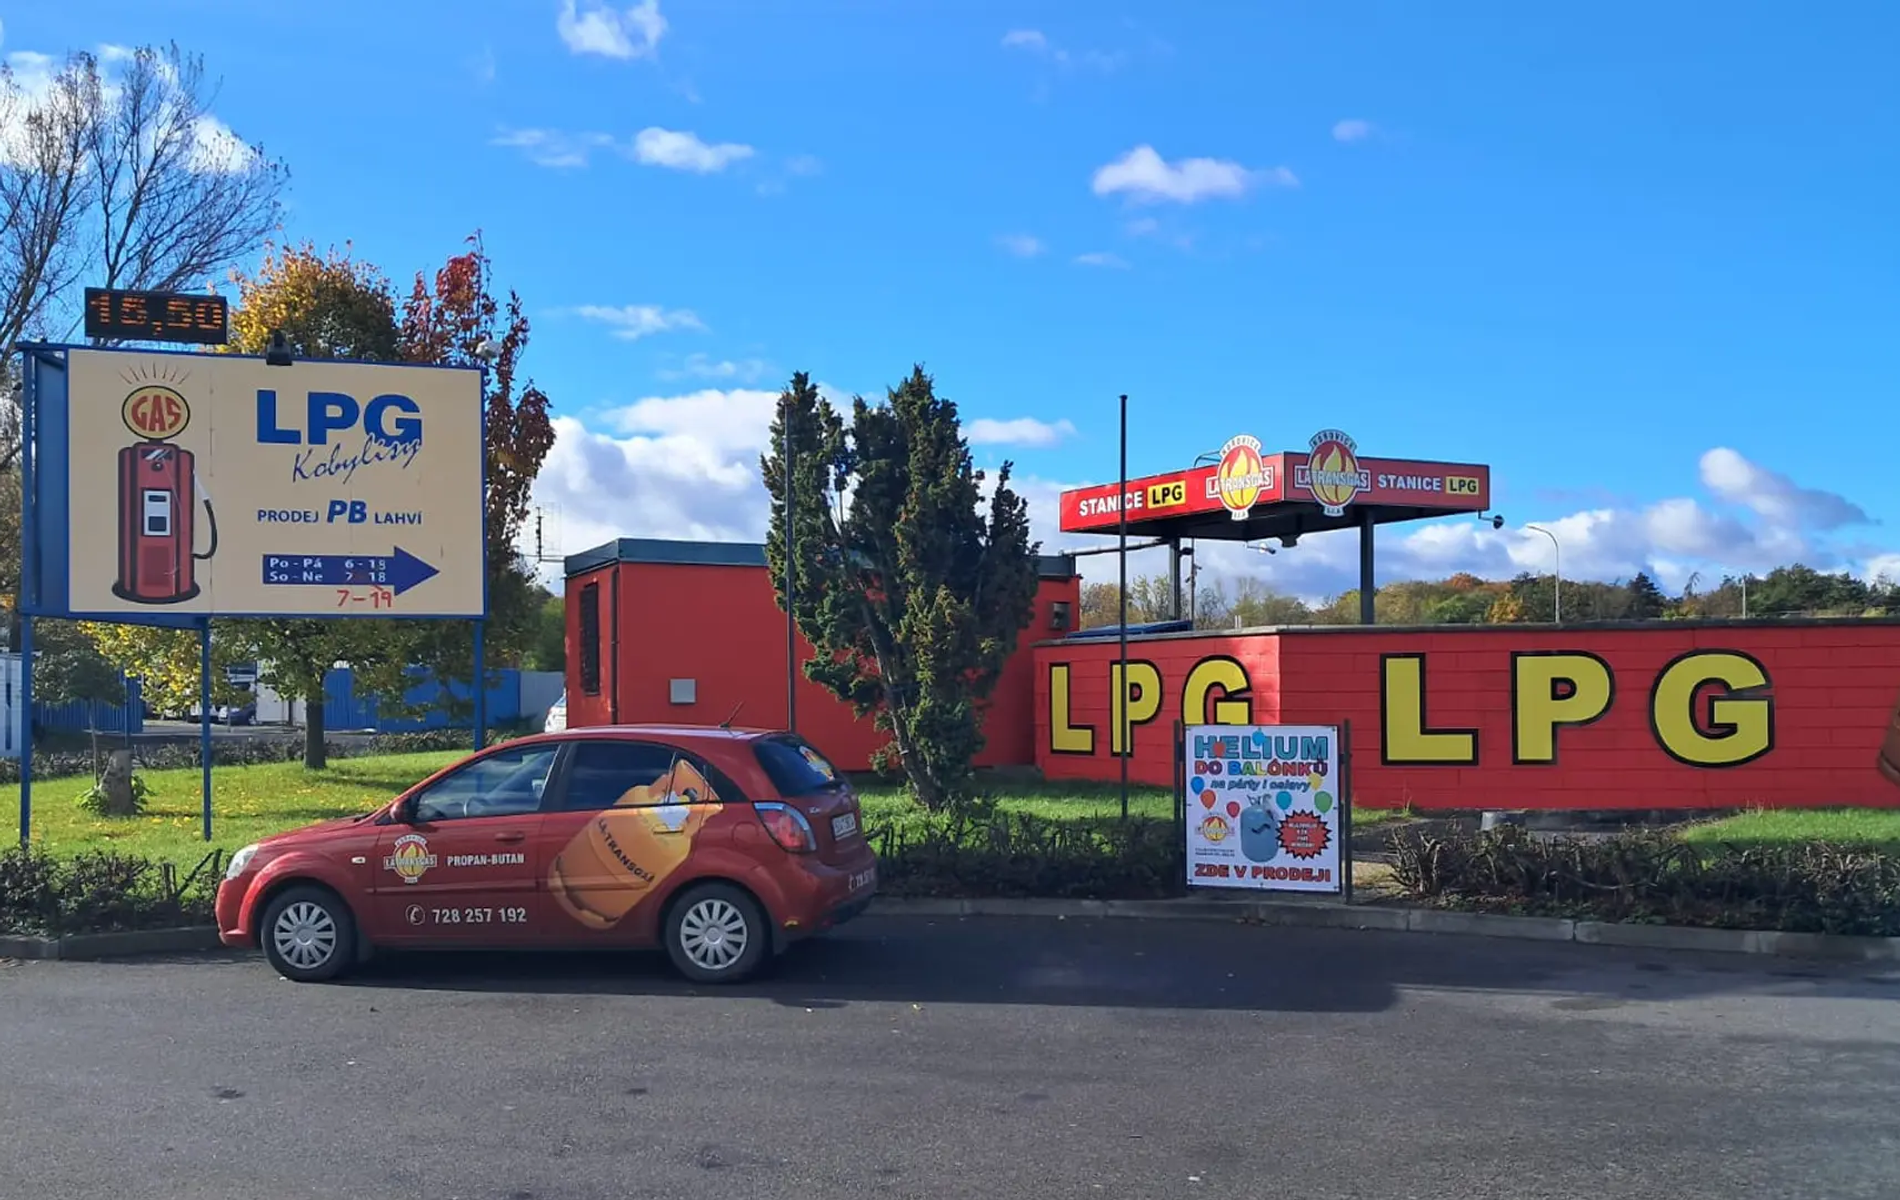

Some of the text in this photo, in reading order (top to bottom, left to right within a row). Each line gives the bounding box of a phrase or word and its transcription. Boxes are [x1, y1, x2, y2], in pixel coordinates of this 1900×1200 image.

[131, 395, 182, 432] GAS
[257, 390, 422, 446] LPG
[292, 433, 421, 485] Kobylisy
[1378, 474, 1477, 493] STANICE LPG
[257, 499, 422, 525] PRODEJ PB LAHVÍ
[1079, 484, 1183, 516] STANICE LPG
[270, 557, 289, 568] Po
[303, 557, 322, 568] Pá
[344, 559, 354, 569] 6
[270, 570, 289, 581] So
[303, 571, 323, 581] Ne
[369, 572, 386, 583] 18
[1049, 654, 1253, 758] LPG
[1380, 649, 1775, 768] LPG
[1194, 735, 1329, 760] HELIUM
[1194, 760, 1223, 775] DO
[447, 853, 525, 867] PROPAN-BUTAN
[1194, 863, 1229, 878] ZDE
[1233, 866, 1247, 879] V
[432, 907, 527, 923] 728 257 192
